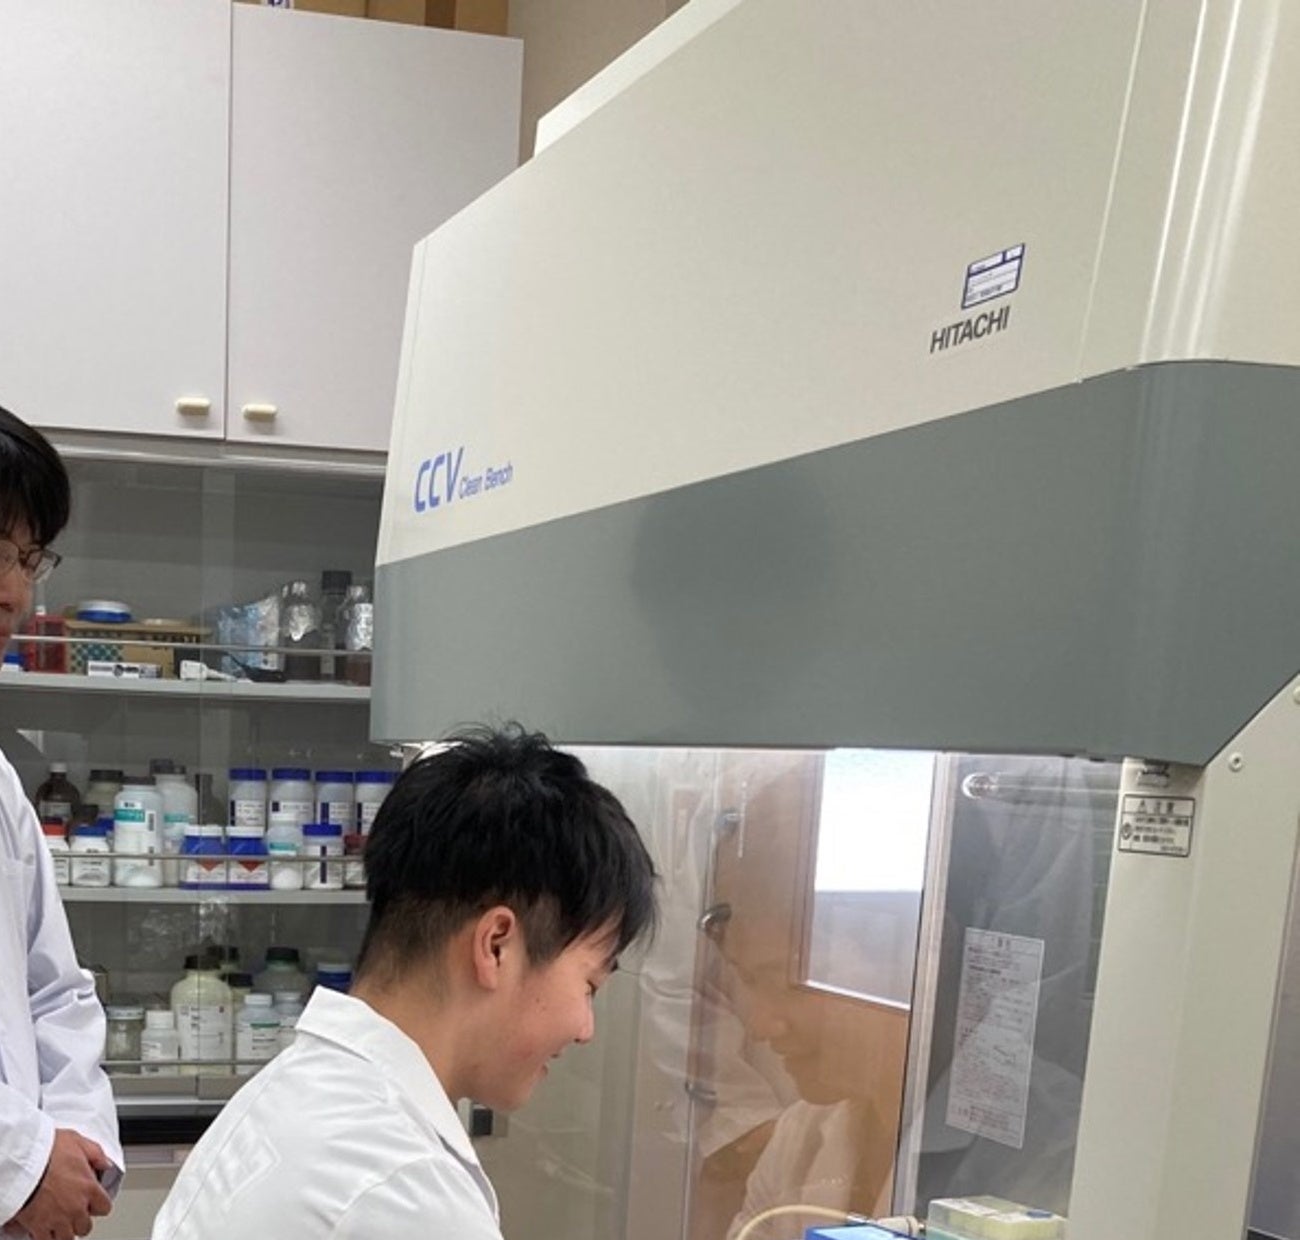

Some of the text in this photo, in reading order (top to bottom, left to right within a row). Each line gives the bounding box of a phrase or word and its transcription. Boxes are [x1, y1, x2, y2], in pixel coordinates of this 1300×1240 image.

[929, 305, 1010, 354] HITACHI
[415, 446, 513, 513] CCV Clean Bench
